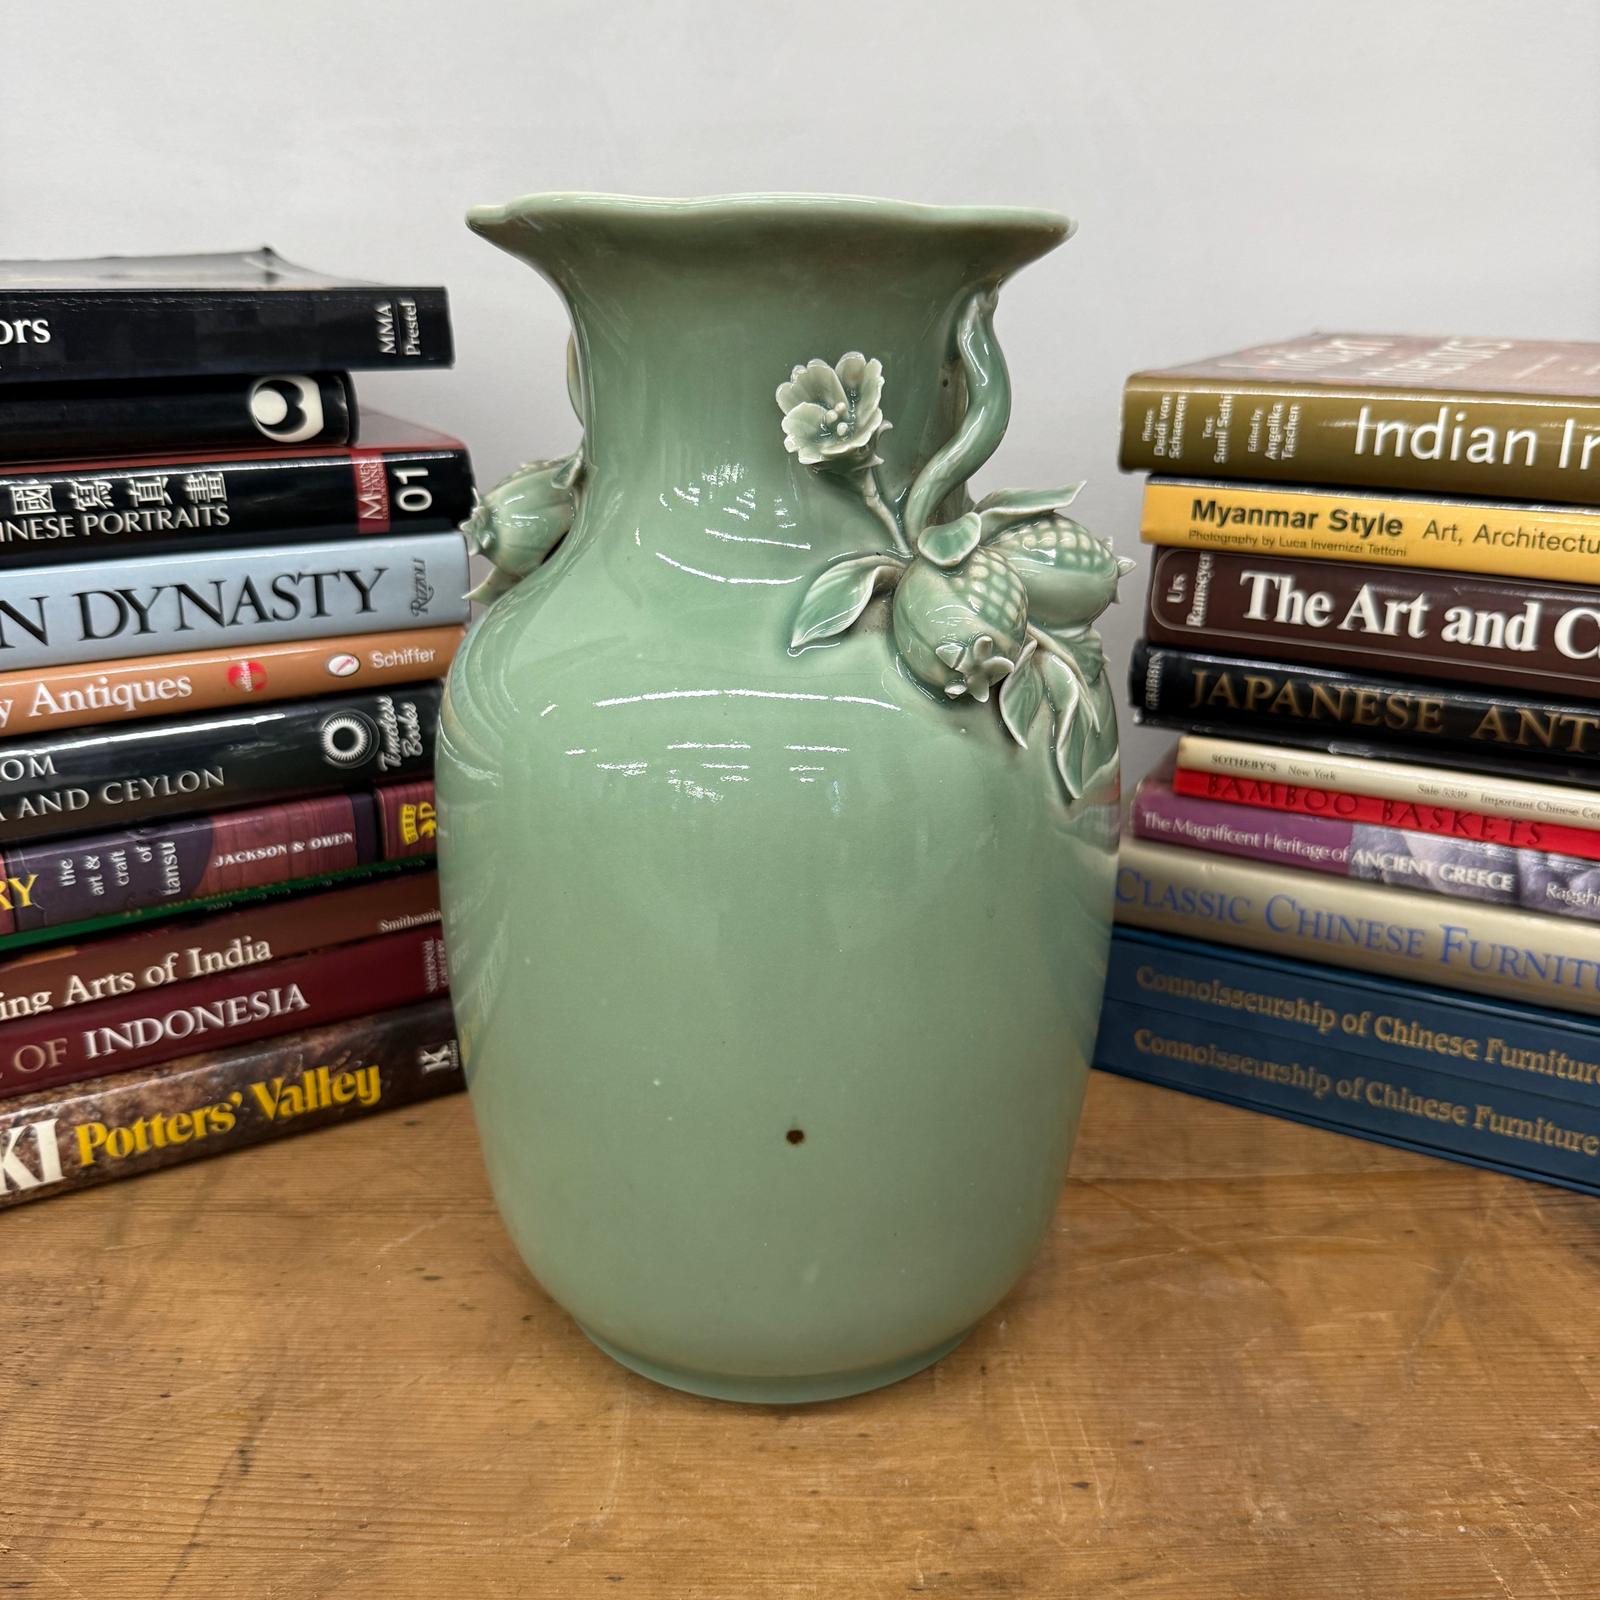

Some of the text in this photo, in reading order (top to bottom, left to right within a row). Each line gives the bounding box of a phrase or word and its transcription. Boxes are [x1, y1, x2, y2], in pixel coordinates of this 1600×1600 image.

[378, 302, 397, 355] MMA
[403, 300, 421, 356] Prestel
[1153, 422, 1168, 456] Deidi
[1169, 393, 1188, 459] Schaewen
[1214, 394, 1233, 464] Sunil Sethi
[1248, 424, 1259, 452] Edited
[1264, 403, 1284, 460] Angelika
[1281, 404, 1301, 460] Taschen
[1354, 405, 1537, 467] Indian
[394, 466, 433, 513] 01
[83, 504, 231, 537] PORTRAITS
[1188, 529, 1258, 547] Photography
[1262, 535, 1275, 548] by
[1278, 537, 1308, 549] Luca
[1310, 538, 1364, 554] Invernizzi
[1190, 498, 1319, 532] Myanmar
[1327, 508, 1404, 540] Style
[1422, 519, 1464, 546] Art,
[0, 567, 390, 650] N DYNASTY
[1166, 573, 1188, 603] Urs
[1186, 551, 1215, 627] Ramseyer
[1240, 569, 1337, 629] The
[1338, 583, 1428, 640] Art
[1440, 601, 1540, 652] and
[372, 647, 437, 669] Schiffer
[29, 673, 193, 718] Antiques
[1190, 668, 1446, 735] JAPANESE
[396, 702, 424, 758] Books
[0, 755, 58, 783] OM
[16, 765, 226, 820] AND CEYLON
[1211, 754, 1277, 772] SOTHEBY'S
[1287, 765, 1310, 778] New
[1313, 768, 1338, 781] York
[1417, 783, 1440, 796] Sale
[1480, 793, 1534, 810] Important
[1537, 801, 1579, 817] Chinese
[1207, 773, 1543, 846] BAMBOO BASKETS
[59, 857, 77, 887] the
[82, 855, 105, 896] art &
[108, 849, 130, 887] craft
[135, 845, 153, 863] of
[158, 840, 182, 896] tansu
[213, 832, 353, 869] JACKSON & OWEN
[1143, 811, 1172, 833] The
[1172, 817, 1259, 848] Magnificent
[1264, 832, 1330, 862] Heritage
[1331, 846, 1350, 863] of
[1352, 849, 1435, 877] ANCIENT
[1439, 861, 1517, 893] GREECE
[1114, 865, 1252, 928] CLASSIC
[1264, 893, 1427, 960] CHINESE
[64, 970, 136, 1006] Arts
[147, 951, 180, 986] of
[187, 934, 273, 978] India
[13, 983, 310, 1074] OF INDONESIA
[1135, 964, 1337, 1034] Connoisseurship
[1341, 1010, 1373, 1035] of
[1372, 1014, 1479, 1061] Chinese
[74, 1090, 244, 1168] Potters'
[250, 1063, 383, 1121] Valley
[1133, 1027, 1600, 1157] Connoisseurship of Chinese Furniture
